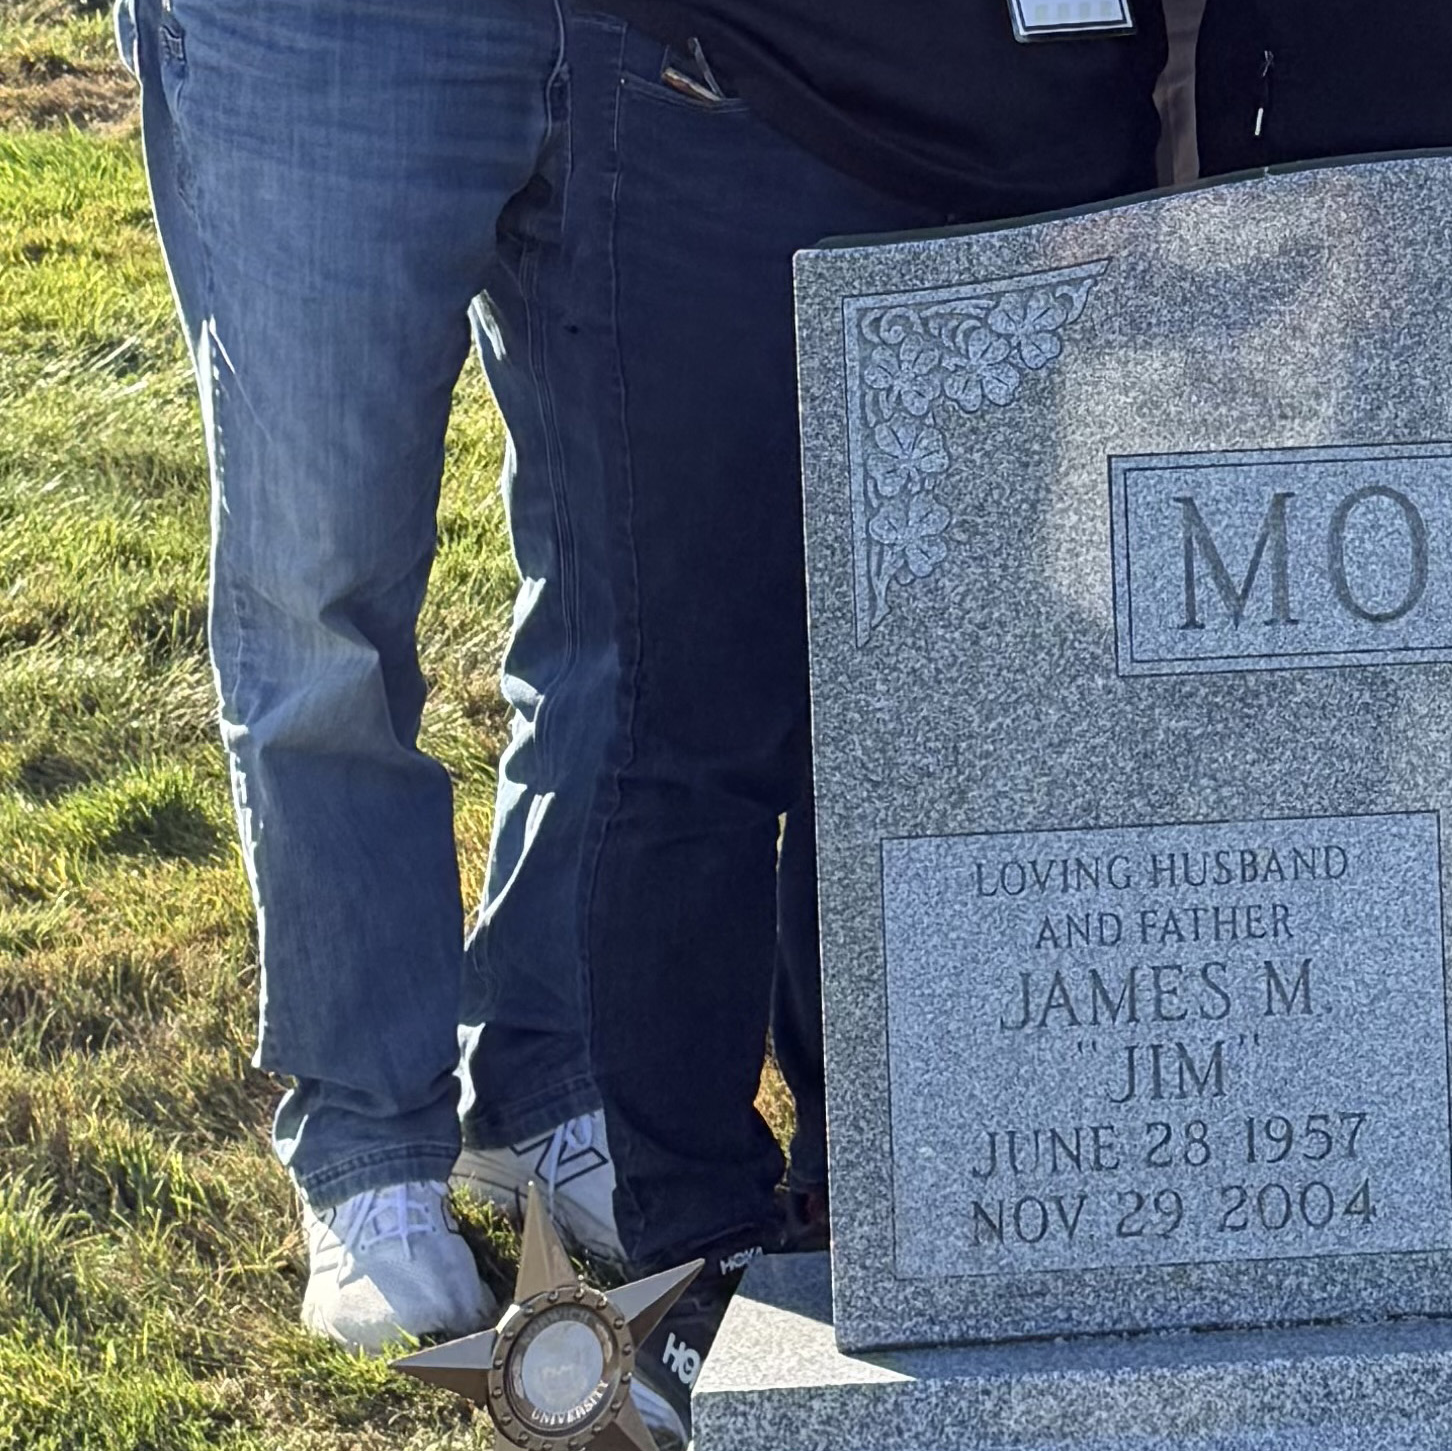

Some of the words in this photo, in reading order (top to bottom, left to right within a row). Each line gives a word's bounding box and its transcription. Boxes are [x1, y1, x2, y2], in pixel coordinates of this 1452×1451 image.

[973, 854, 1133, 898] LOVING
[1150, 845, 1349, 890] HUSBAND
[1034, 911, 1123, 949] AND
[1139, 903, 1295, 944] FATHER
[1000, 960, 1234, 1032] JAMES
[971, 1125, 1120, 1180] JUNE
[1145, 1120, 1212, 1168] 28
[1245, 1111, 1367, 1166] 1957
[971, 1194, 1087, 1247] NOV
[1115, 1189, 1184, 1239] 29
[1219, 1178, 1377, 1234] 2004
[663, 1331, 701, 1389] HO
[531, 1379, 610, 1426] UNIVERSITY
